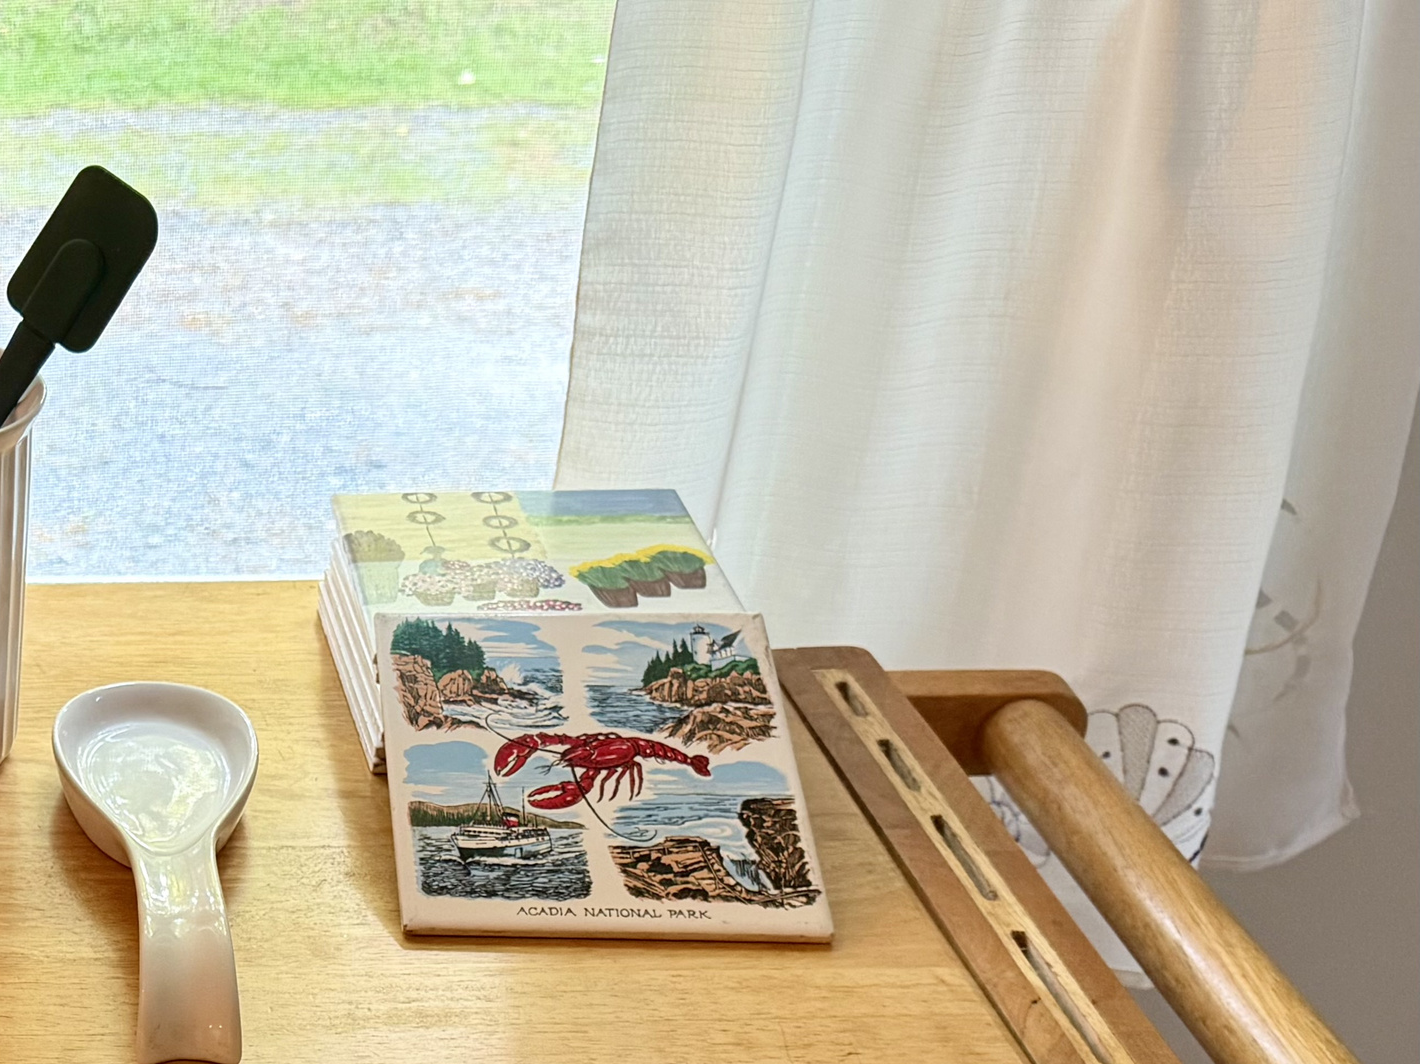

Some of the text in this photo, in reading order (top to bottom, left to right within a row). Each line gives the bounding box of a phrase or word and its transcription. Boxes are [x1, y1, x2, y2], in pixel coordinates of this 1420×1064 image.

[516, 906, 712, 920] ACADIA NATIONAL PARK
